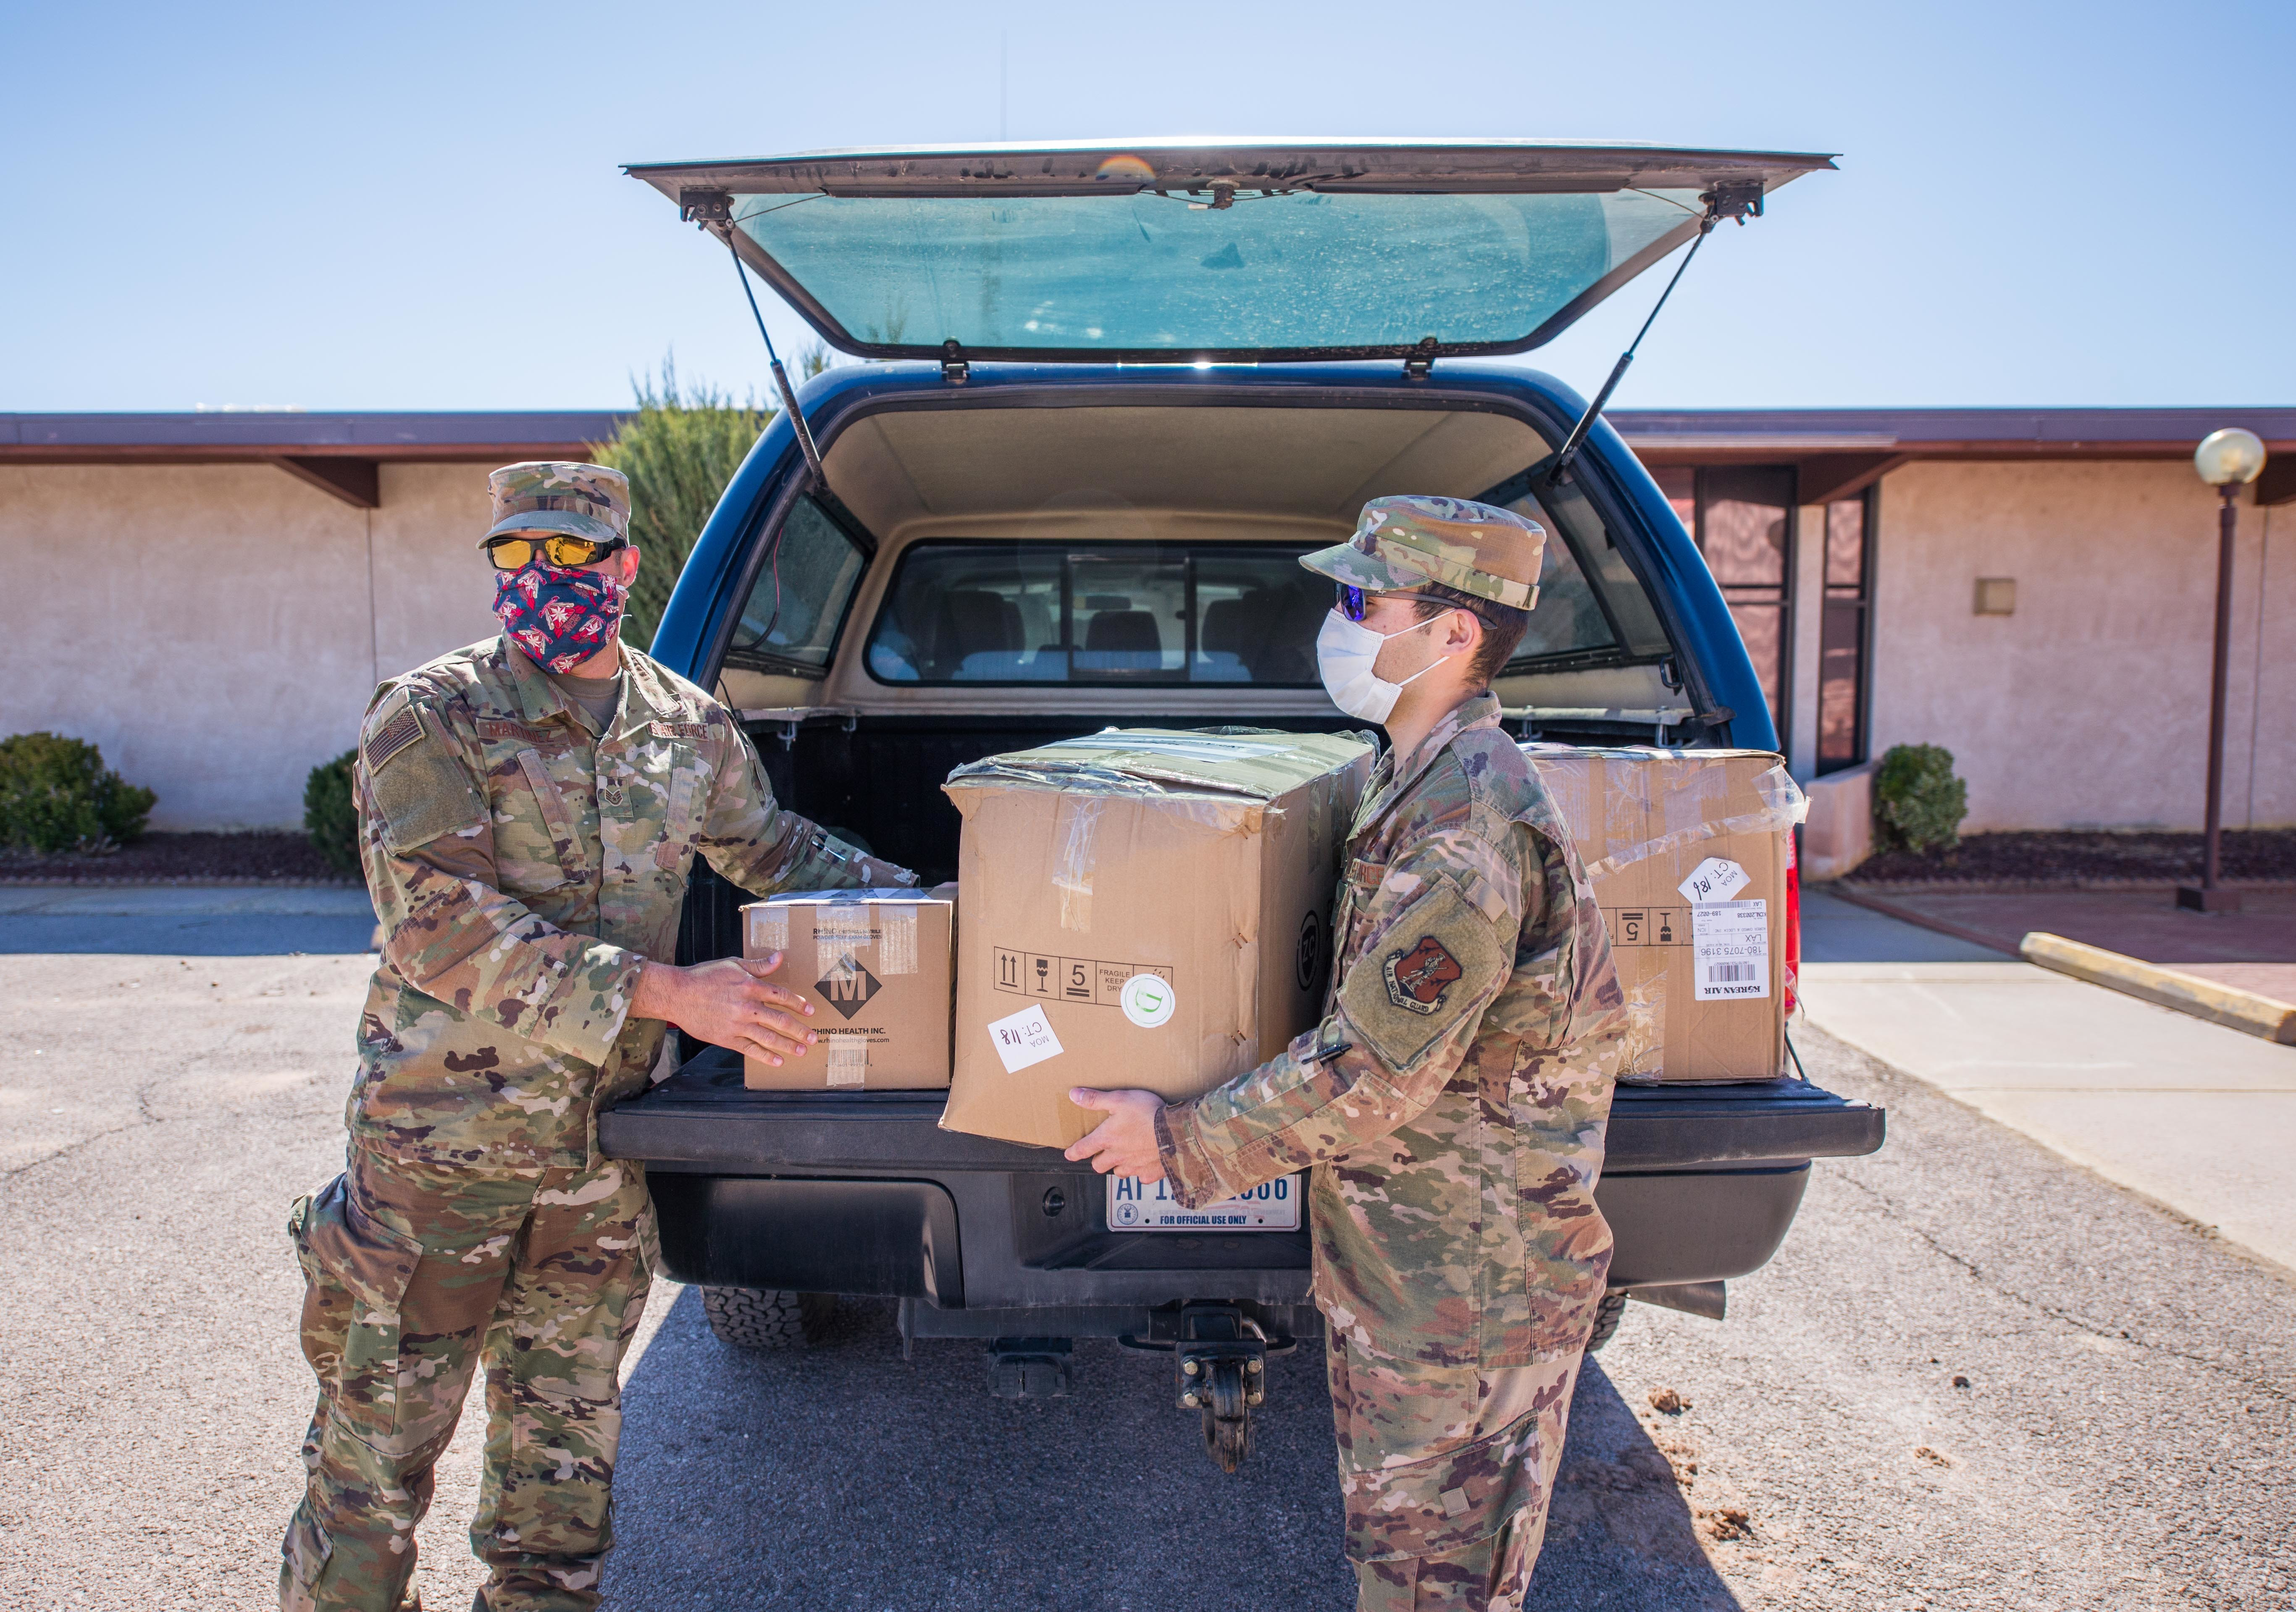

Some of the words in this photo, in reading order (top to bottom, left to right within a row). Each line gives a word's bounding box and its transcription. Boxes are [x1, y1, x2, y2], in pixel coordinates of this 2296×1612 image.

[488, 721, 554, 742] MARTINEZ
[660, 724, 678, 736] AIR
[678, 724, 708, 739] FORCE
[1710, 862, 1729, 879] CT:
[1721, 870, 1737, 886] MOA
[1626, 922, 1639, 941] 5
[1700, 947, 1722, 956] 3196
[1724, 946, 1761, 955] 180-7075
[1072, 964, 1086, 986] 5
[1099, 969, 1130, 978] FRAGILE
[1388, 980, 1408, 1005] NATIONAL
[1410, 1001, 1429, 1012] GUARD
[1723, 985, 1761, 994] KOREAN
[1022, 1022, 1042, 1037] CT:
[1029, 1035, 1050, 1047] MOA
[1160, 1215, 1175, 1225] FOR
[1176, 1215, 1211, 1225] OFFICIAL
[1212, 1215, 1227, 1225] USE
[1228, 1215, 1247, 1224] ONLY
